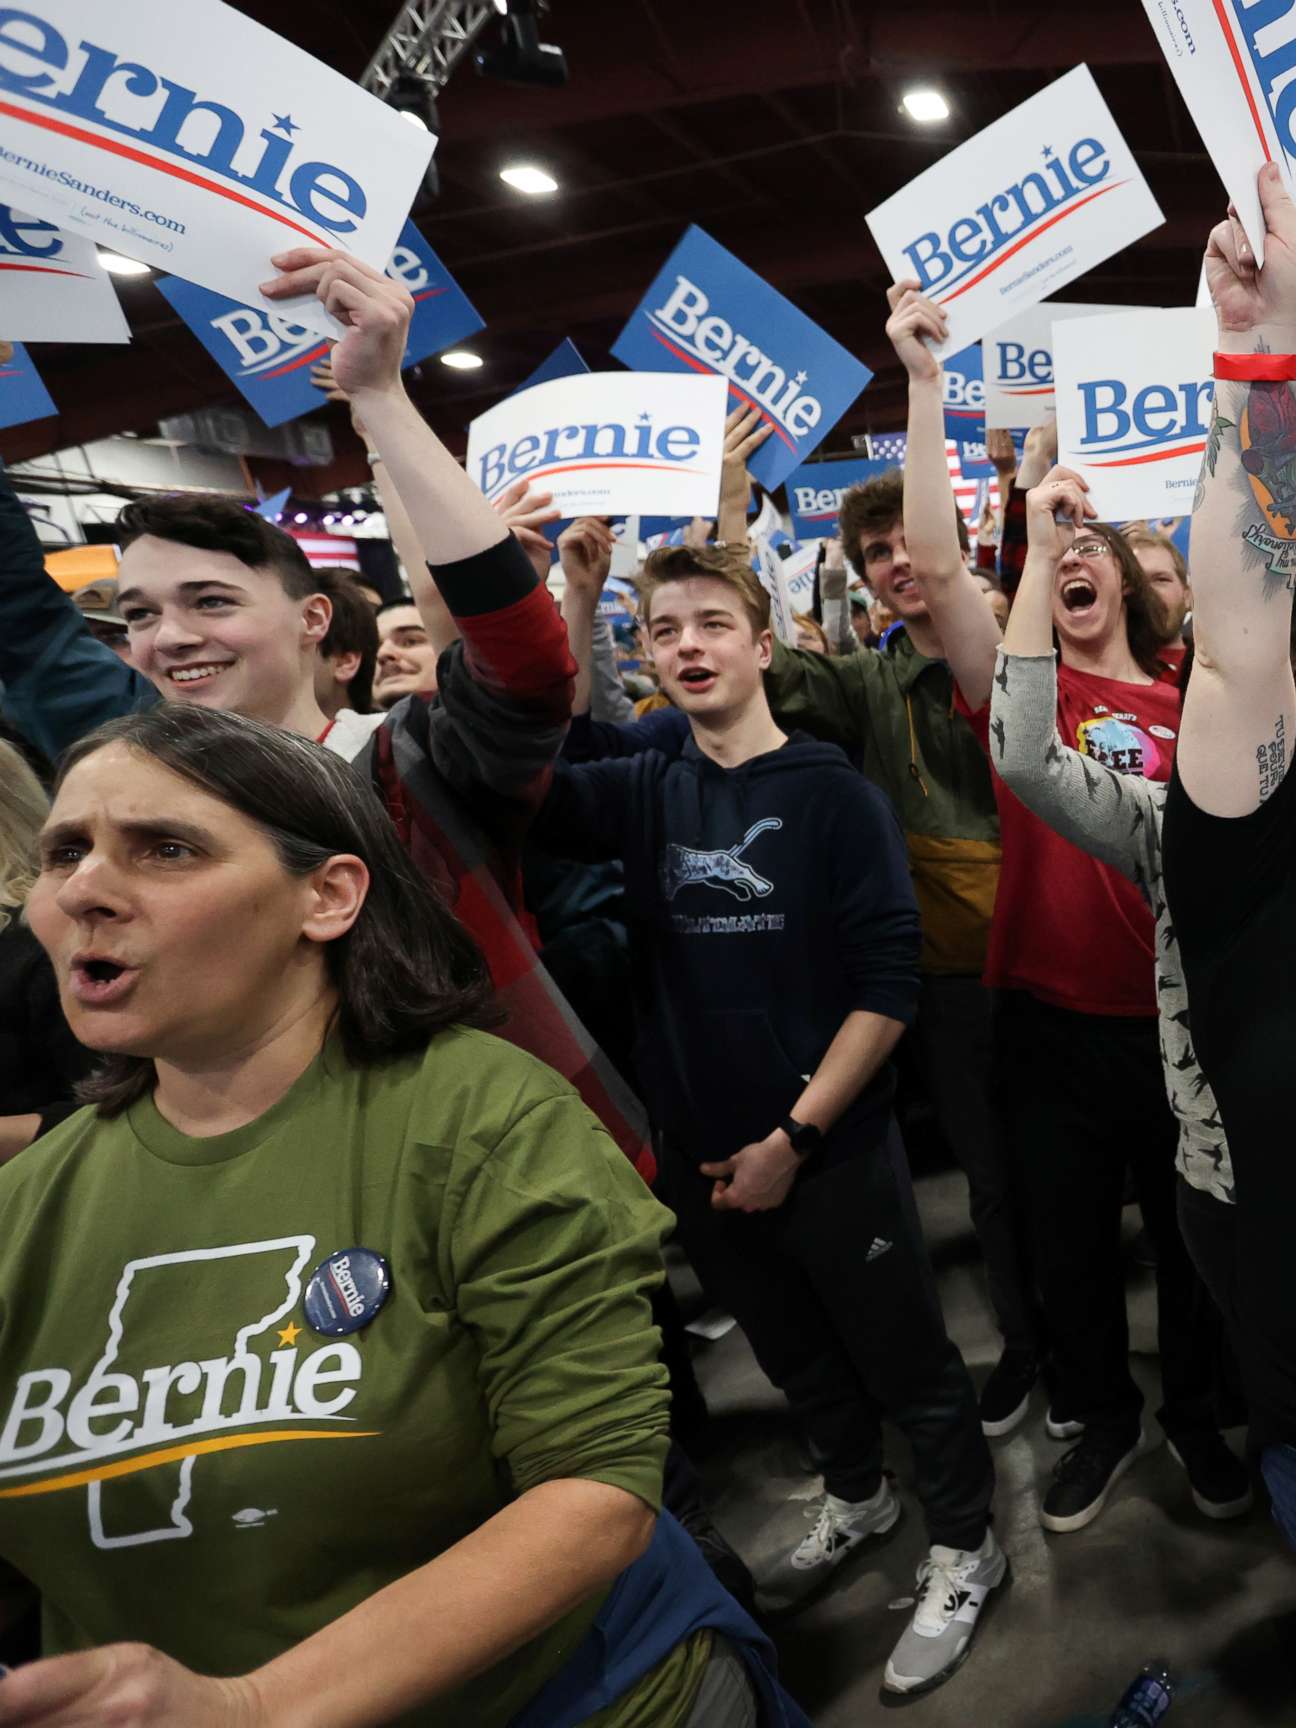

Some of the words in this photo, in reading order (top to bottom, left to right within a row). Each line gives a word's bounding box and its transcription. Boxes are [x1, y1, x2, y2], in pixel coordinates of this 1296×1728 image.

[0, 6, 367, 234] ernie
[0, 145, 186, 235] ernieSanders.com
[902, 136, 1112, 286] Bernie
[654, 275, 822, 438] Bernie
[480, 411, 701, 495] Bernie
[794, 486, 850, 513] Ber
[331, 1255, 366, 1317] Bernie
[0, 1320, 363, 1463] Bernie
